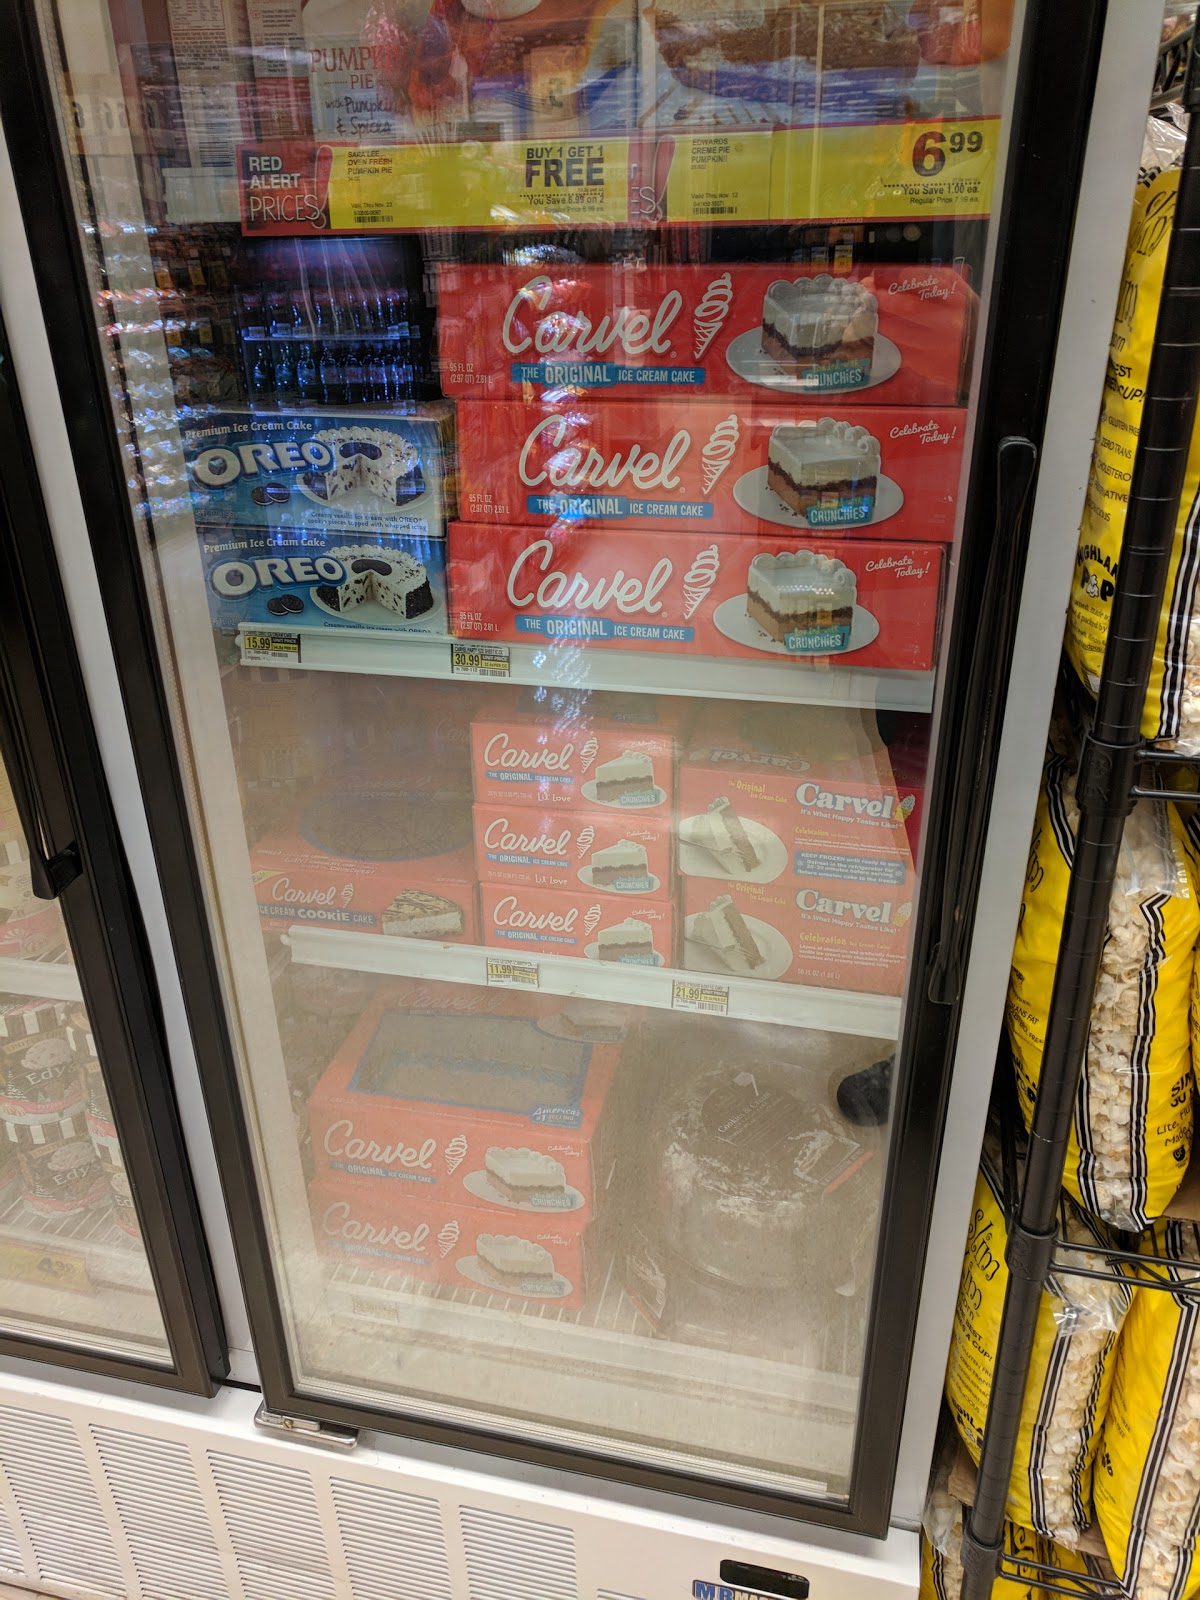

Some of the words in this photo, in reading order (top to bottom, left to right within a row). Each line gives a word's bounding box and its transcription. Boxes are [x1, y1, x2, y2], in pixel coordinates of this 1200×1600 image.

[350, 74, 374, 90] PIE
[692, 138, 728, 146] EDWARDS
[692, 146, 717, 154] CREME
[718, 146, 730, 154] PIE
[527, 148, 552, 158] BUY
[557, 147, 563, 158] 1
[568, 146, 594, 158] GET
[600, 146, 604, 157] 1
[249, 156, 283, 172] RED
[381, 166, 392, 174] PIE
[250, 173, 300, 189] ALERT
[526, 158, 604, 188] FREE
[903, 187, 920, 196] You
[922, 186, 944, 194] Save
[947, 184, 964, 194] 1.00
[528, 196, 544, 205] You
[546, 196, 566, 204] Save
[568, 196, 584, 204] 6.99
[600, 196, 604, 204] 2
[910, 197, 935, 205] Regular
[888, 275, 939, 295] Celebrate
[502, 275, 682, 354] Carvel
[522, 366, 539, 379] THE
[545, 364, 612, 384] ORIGINAL
[618, 369, 633, 381] ICE
[636, 370, 668, 382] CREAM
[671, 370, 696, 383] CAKE
[185, 425, 231, 440] Premium
[232, 422, 248, 434] Ice
[250, 421, 284, 432] Cream
[286, 420, 312, 430] Cake
[889, 420, 940, 439] Celebrate
[1108, 416, 1128, 433] GLUTEN
[518, 414, 690, 490] Carvel
[1100, 437, 1115, 451] ZERO
[1116, 443, 1132, 460] TRANS
[194, 442, 331, 486] OREO
[536, 498, 554, 512] THE
[560, 496, 622, 515] ORIGINAL
[630, 502, 644, 515] ICE
[646, 502, 678, 516] CREAM
[681, 504, 703, 517] CAKE
[203, 541, 248, 554] Premium
[250, 539, 264, 548] Ice
[266, 538, 298, 548] Cream
[300, 538, 326, 547] Cake
[865, 555, 914, 572] Celebrate
[212, 557, 344, 596] OREO
[507, 540, 673, 614] Carvel
[524, 618, 541, 630] THE
[546, 618, 608, 636] ORIGINAL
[614, 624, 628, 637] ICE
[630, 626, 660, 639] CREAM
[662, 628, 685, 640] CAKE
[247, 636, 270, 648] 15.99
[455, 654, 480, 666] 30.99
[484, 732, 574, 770] Carvel
[500, 772, 532, 780] ORIGINAL
[736, 780, 766, 793] Original
[552, 793, 572, 802] Love
[758, 793, 774, 801] Cream
[796, 782, 895, 819] Carvel
[812, 809, 831, 819] What
[832, 814, 855, 824] Happy
[856, 818, 880, 828] Tastes
[484, 818, 572, 856] Carvel
[500, 854, 530, 864] ORIGINAL
[819, 853, 846, 862] FROZEN
[550, 876, 568, 884] Love
[736, 882, 764, 894] Original
[272, 878, 336, 906] Carvel
[493, 896, 578, 932] Carvel
[796, 888, 892, 924] Carvel
[259, 905, 270, 915] CE
[270, 906, 296, 916] CREAM
[353, 914, 374, 924] CAKE
[812, 914, 830, 923] What
[832, 918, 854, 928] Happy
[508, 931, 538, 940] ORIGINAL
[800, 932, 847, 946] Celebration
[490, 964, 512, 974] 11.99
[676, 986, 700, 999] 21.99
[324, 1119, 436, 1169] Carvel
[348, 1164, 386, 1176] ORIGINAL
[398, 1172, 416, 1180] CREAM
[322, 1201, 430, 1252] Carvel
